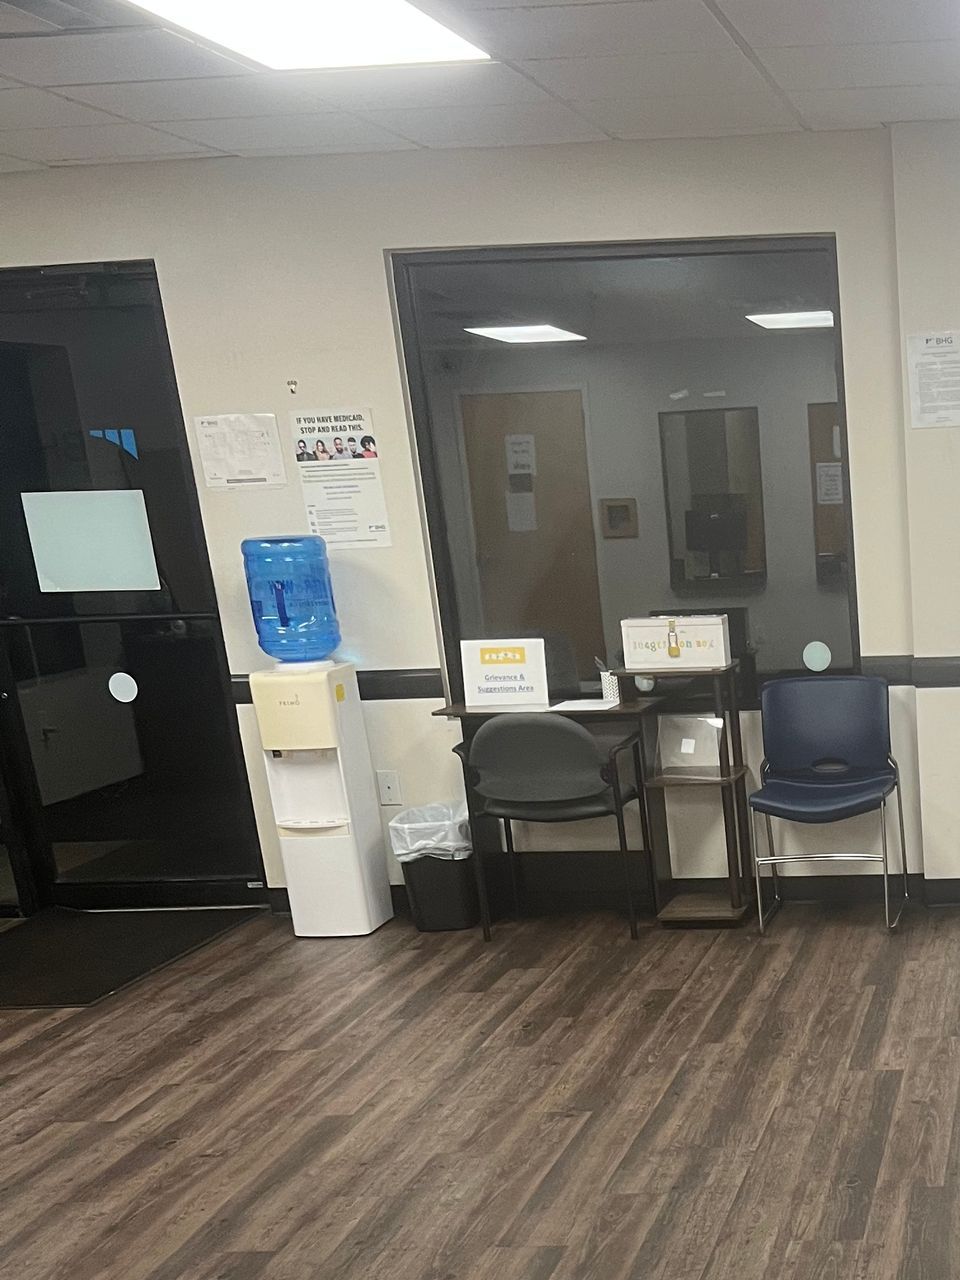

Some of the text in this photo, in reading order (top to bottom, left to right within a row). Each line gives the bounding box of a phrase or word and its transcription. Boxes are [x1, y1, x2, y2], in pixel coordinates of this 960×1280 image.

[935, 336, 953, 345] BHG
[296, 417, 302, 425] IF
[303, 416, 316, 424] YOU
[316, 415, 333, 424] HAVE
[300, 426, 316, 435] STOP
[317, 425, 330, 433] AND
[331, 424, 348, 432] READ
[484, 672, 526, 682] Grievance &
[477, 684, 534, 694] Suggestions Area
